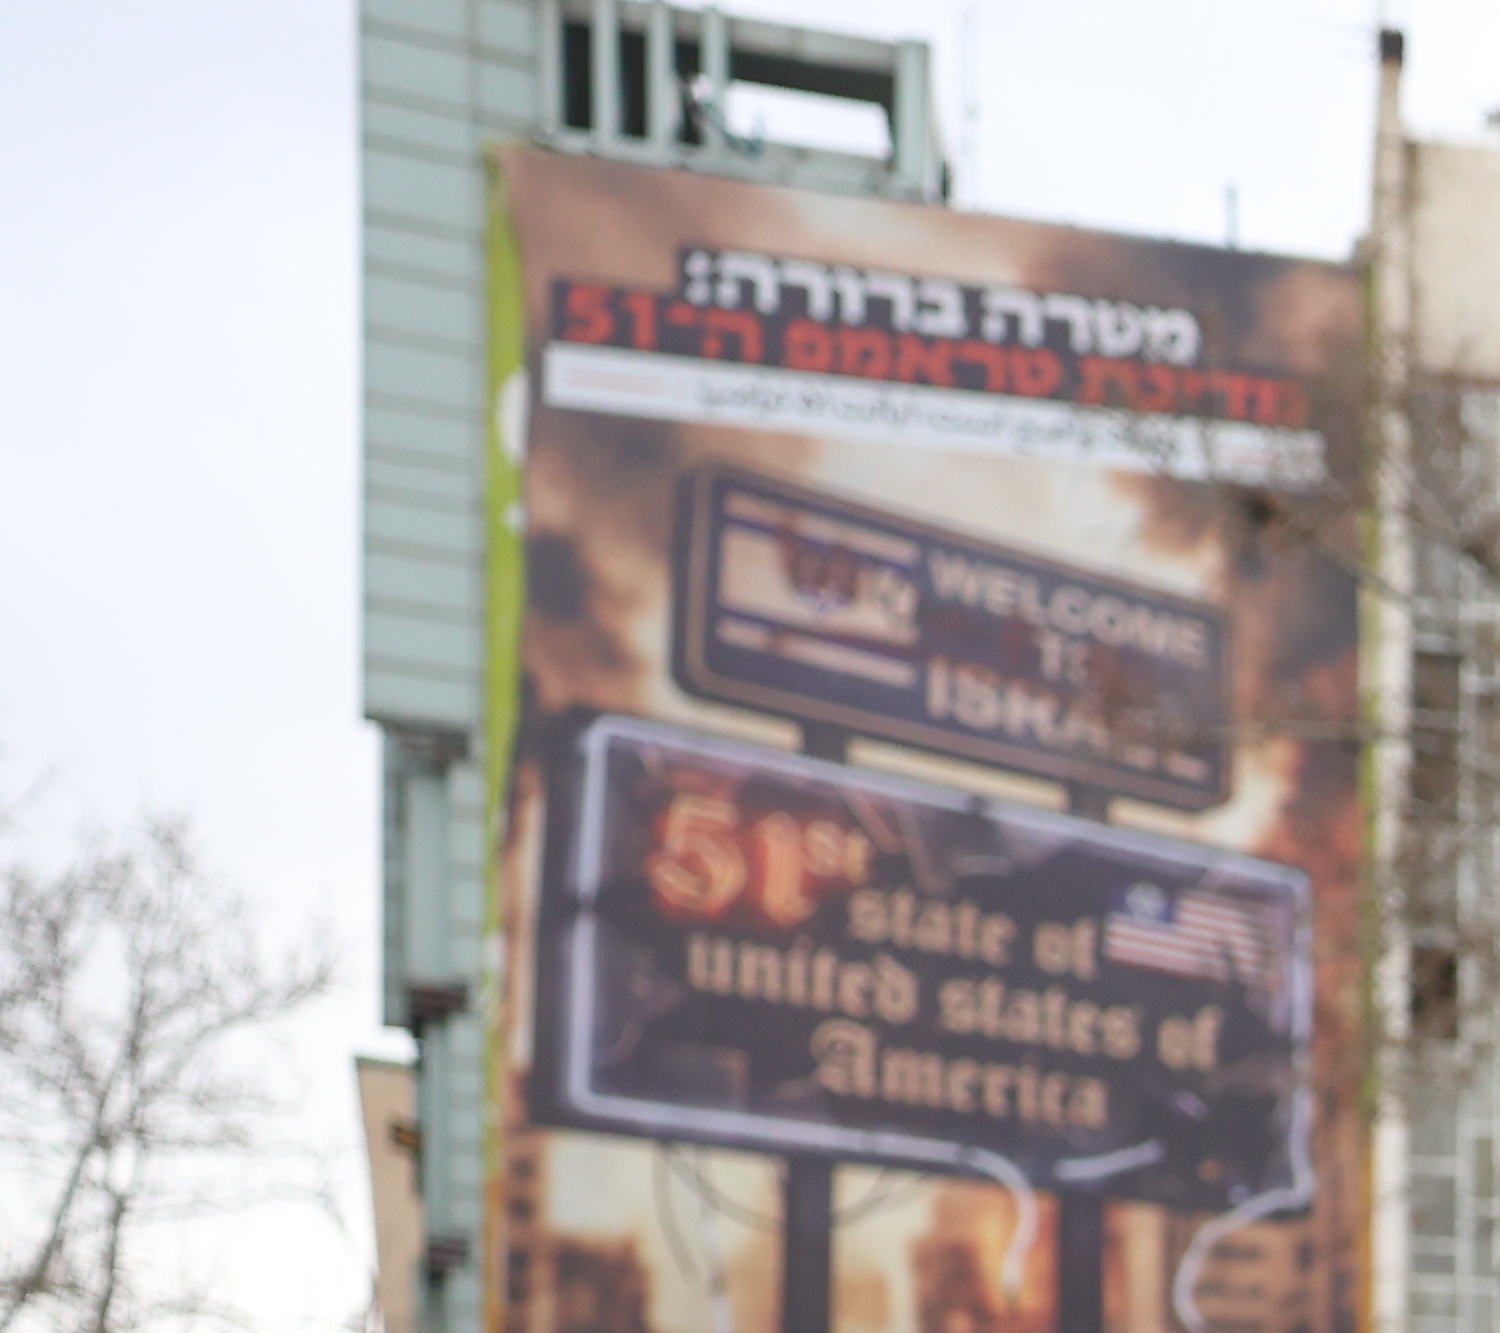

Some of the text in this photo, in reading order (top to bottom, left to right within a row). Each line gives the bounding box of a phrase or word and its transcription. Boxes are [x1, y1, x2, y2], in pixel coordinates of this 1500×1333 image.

[926, 545, 1205, 668] WELCOME
[846, 884, 1101, 980] state of
[687, 931, 1225, 1072] united states of
[809, 1018, 1110, 1131] America
